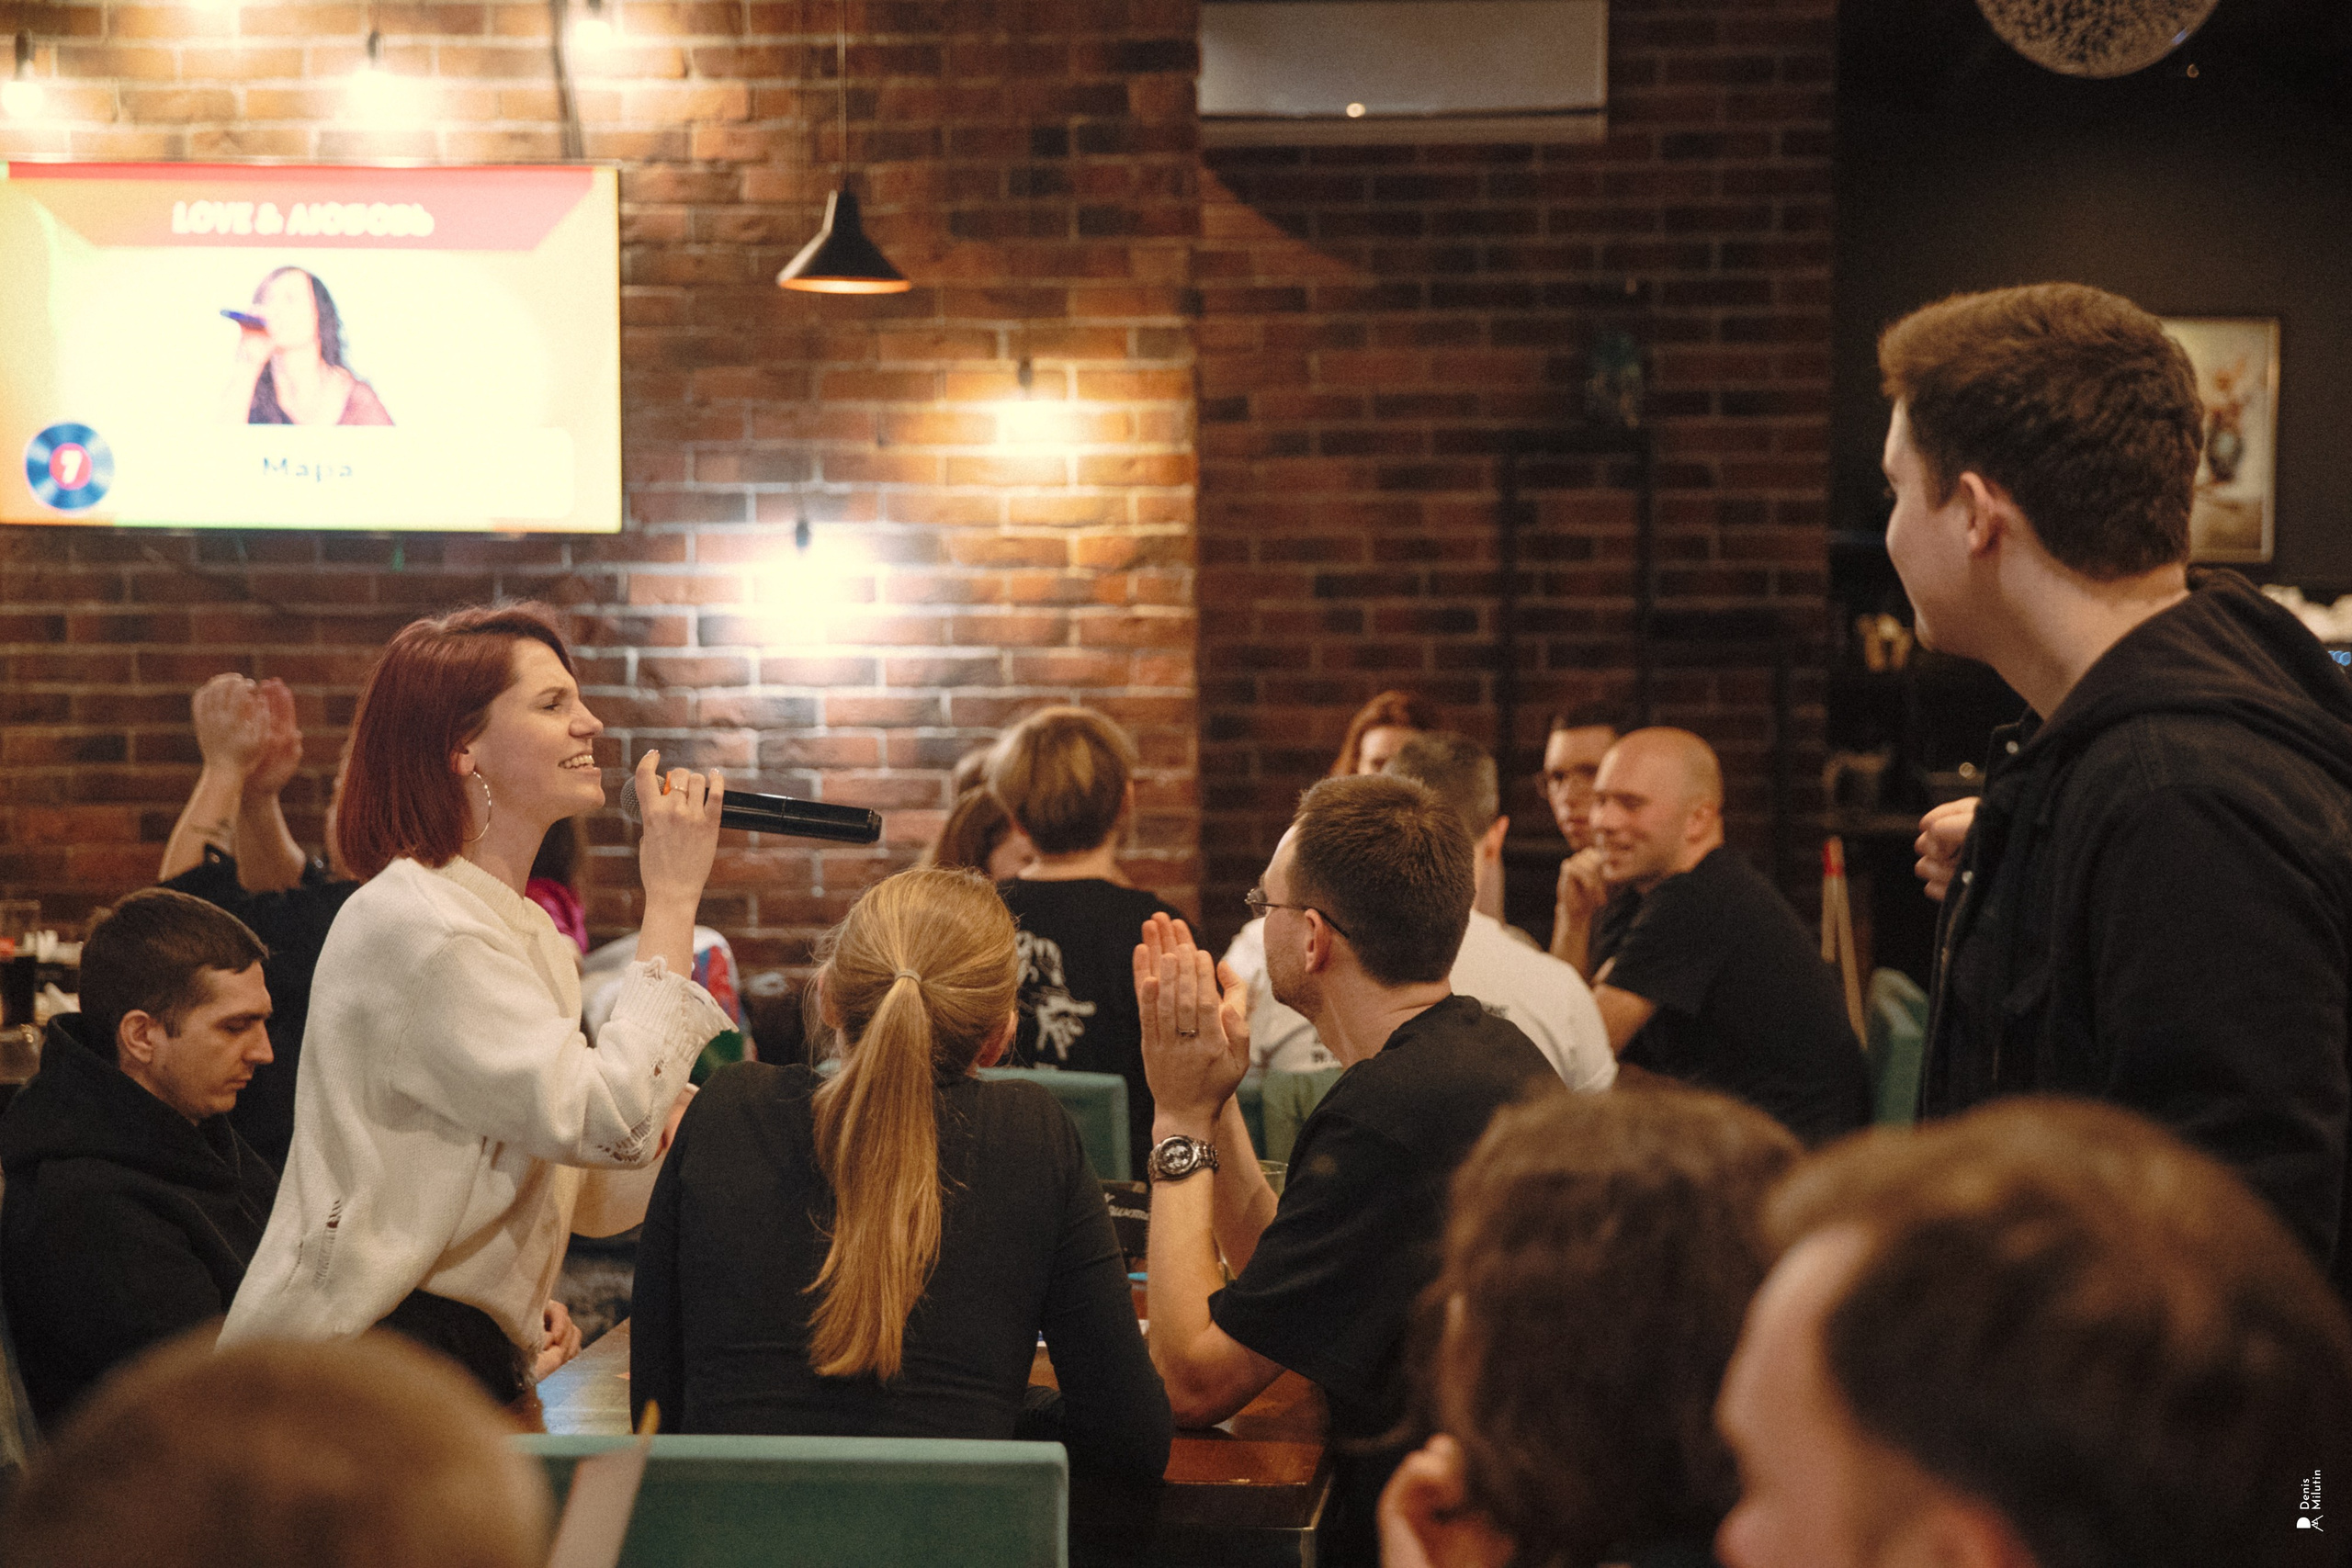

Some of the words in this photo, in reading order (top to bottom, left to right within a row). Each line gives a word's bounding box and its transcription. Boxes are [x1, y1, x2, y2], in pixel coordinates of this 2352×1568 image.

[172, 200, 254, 234] LOVE
[254, 201, 284, 235] &
[61, 449, 83, 484] 7
